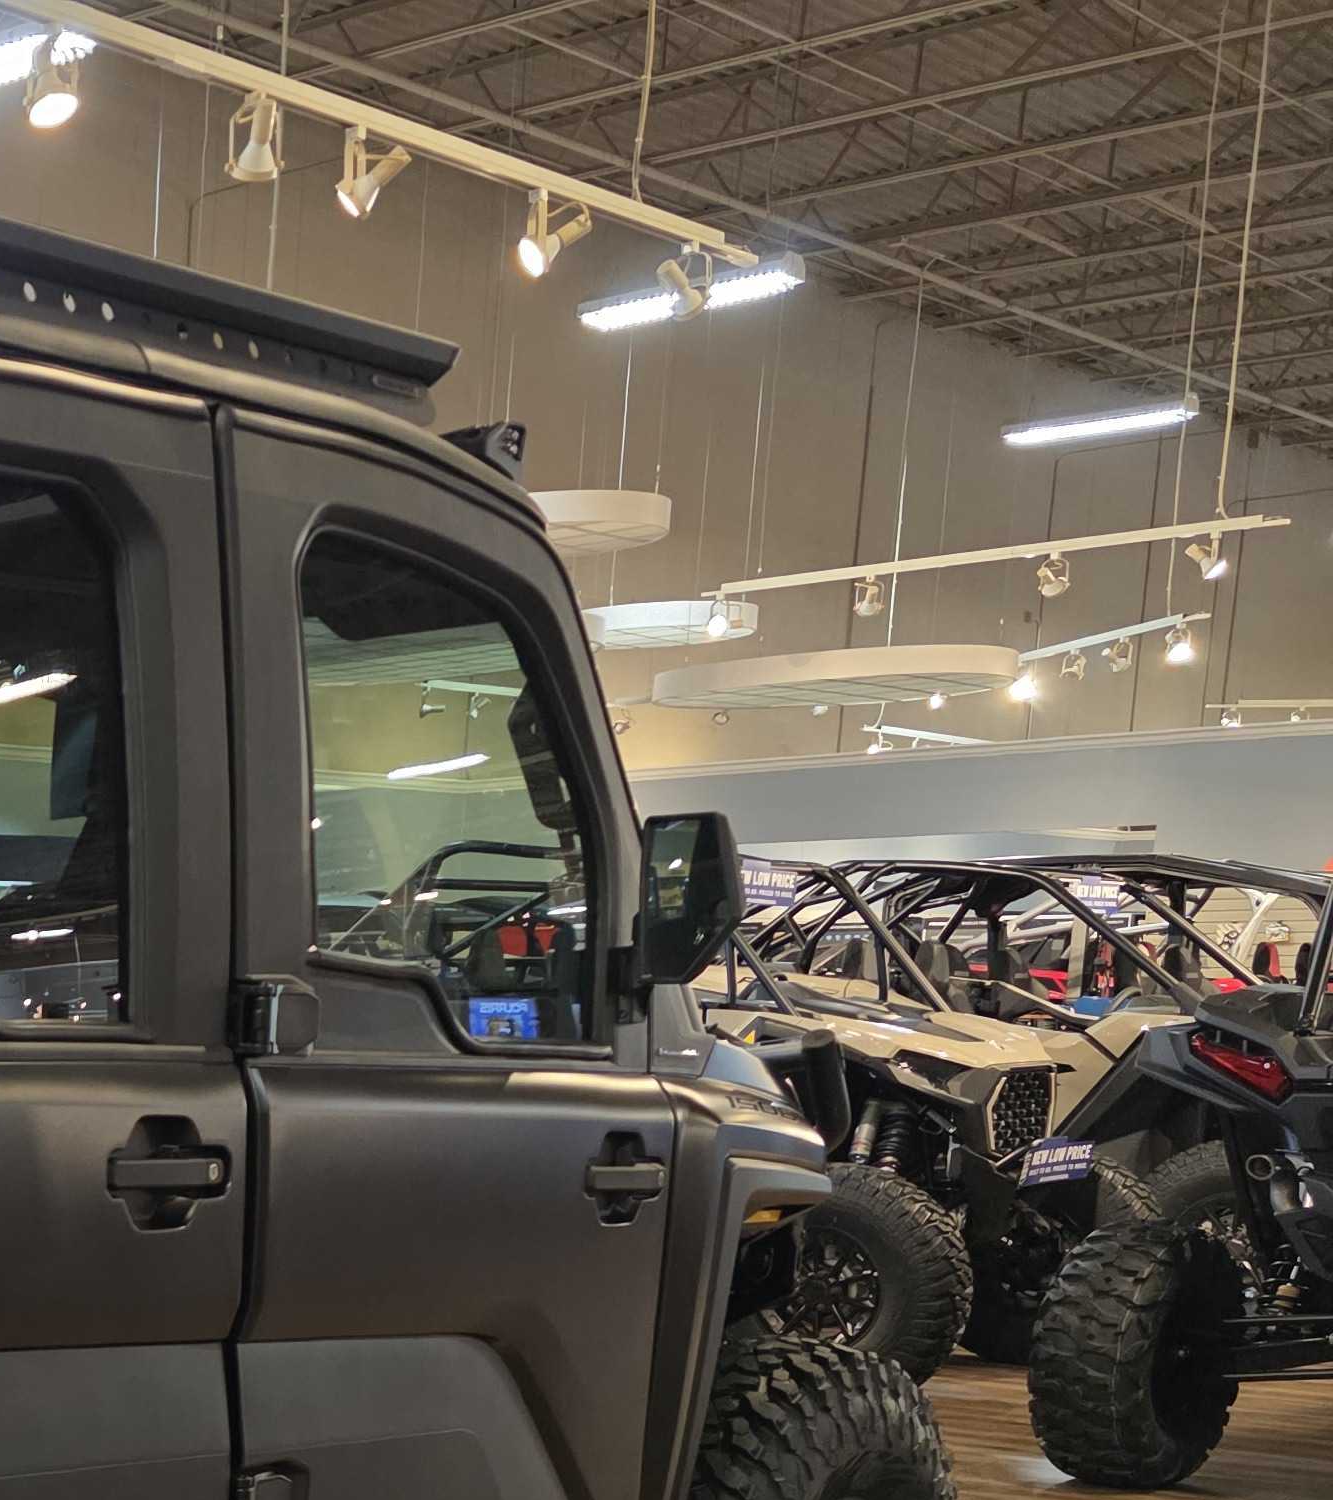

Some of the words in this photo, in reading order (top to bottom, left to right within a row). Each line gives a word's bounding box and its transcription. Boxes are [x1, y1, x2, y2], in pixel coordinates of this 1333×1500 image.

[771, 872, 796, 888] PRICE
[1032, 1149, 1049, 1165] NEW
[1048, 1147, 1067, 1163] LOW
[1066, 1144, 1093, 1160] PRICE
